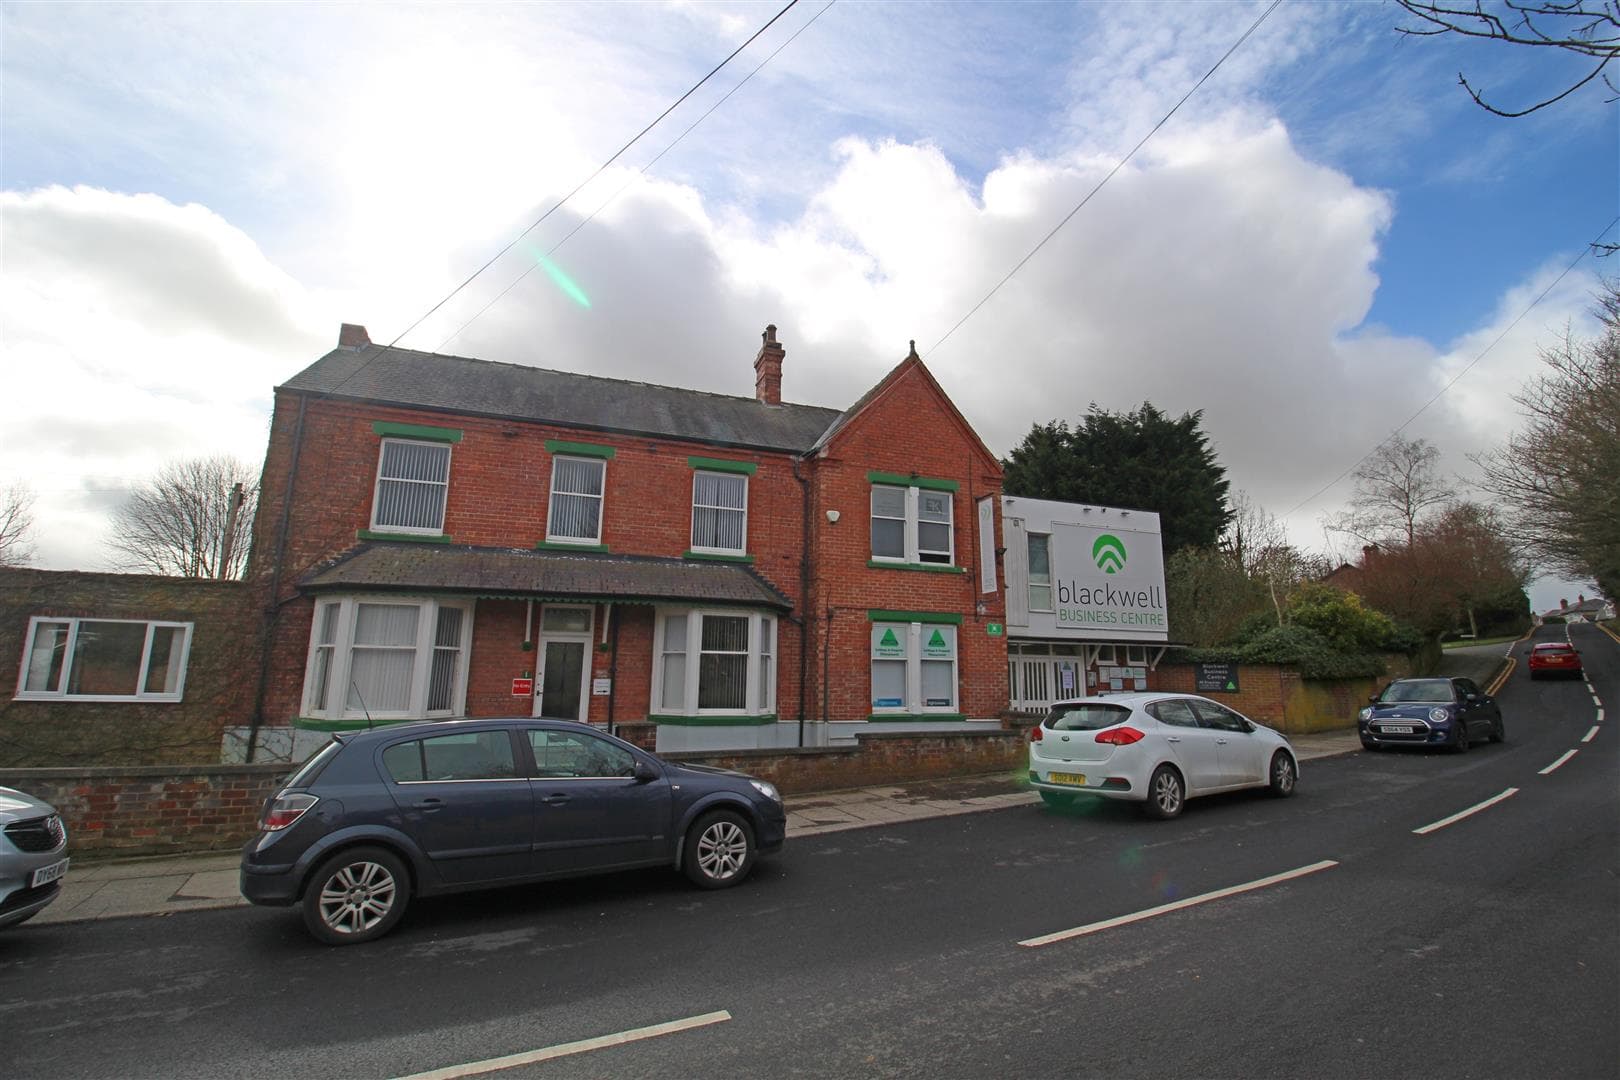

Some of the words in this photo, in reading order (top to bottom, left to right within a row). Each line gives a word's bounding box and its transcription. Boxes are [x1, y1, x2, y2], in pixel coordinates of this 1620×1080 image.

[1057, 579, 1163, 609] blackwell
[1060, 608, 1118, 624] BUSINESS
[1120, 612, 1165, 626] CENTRE
